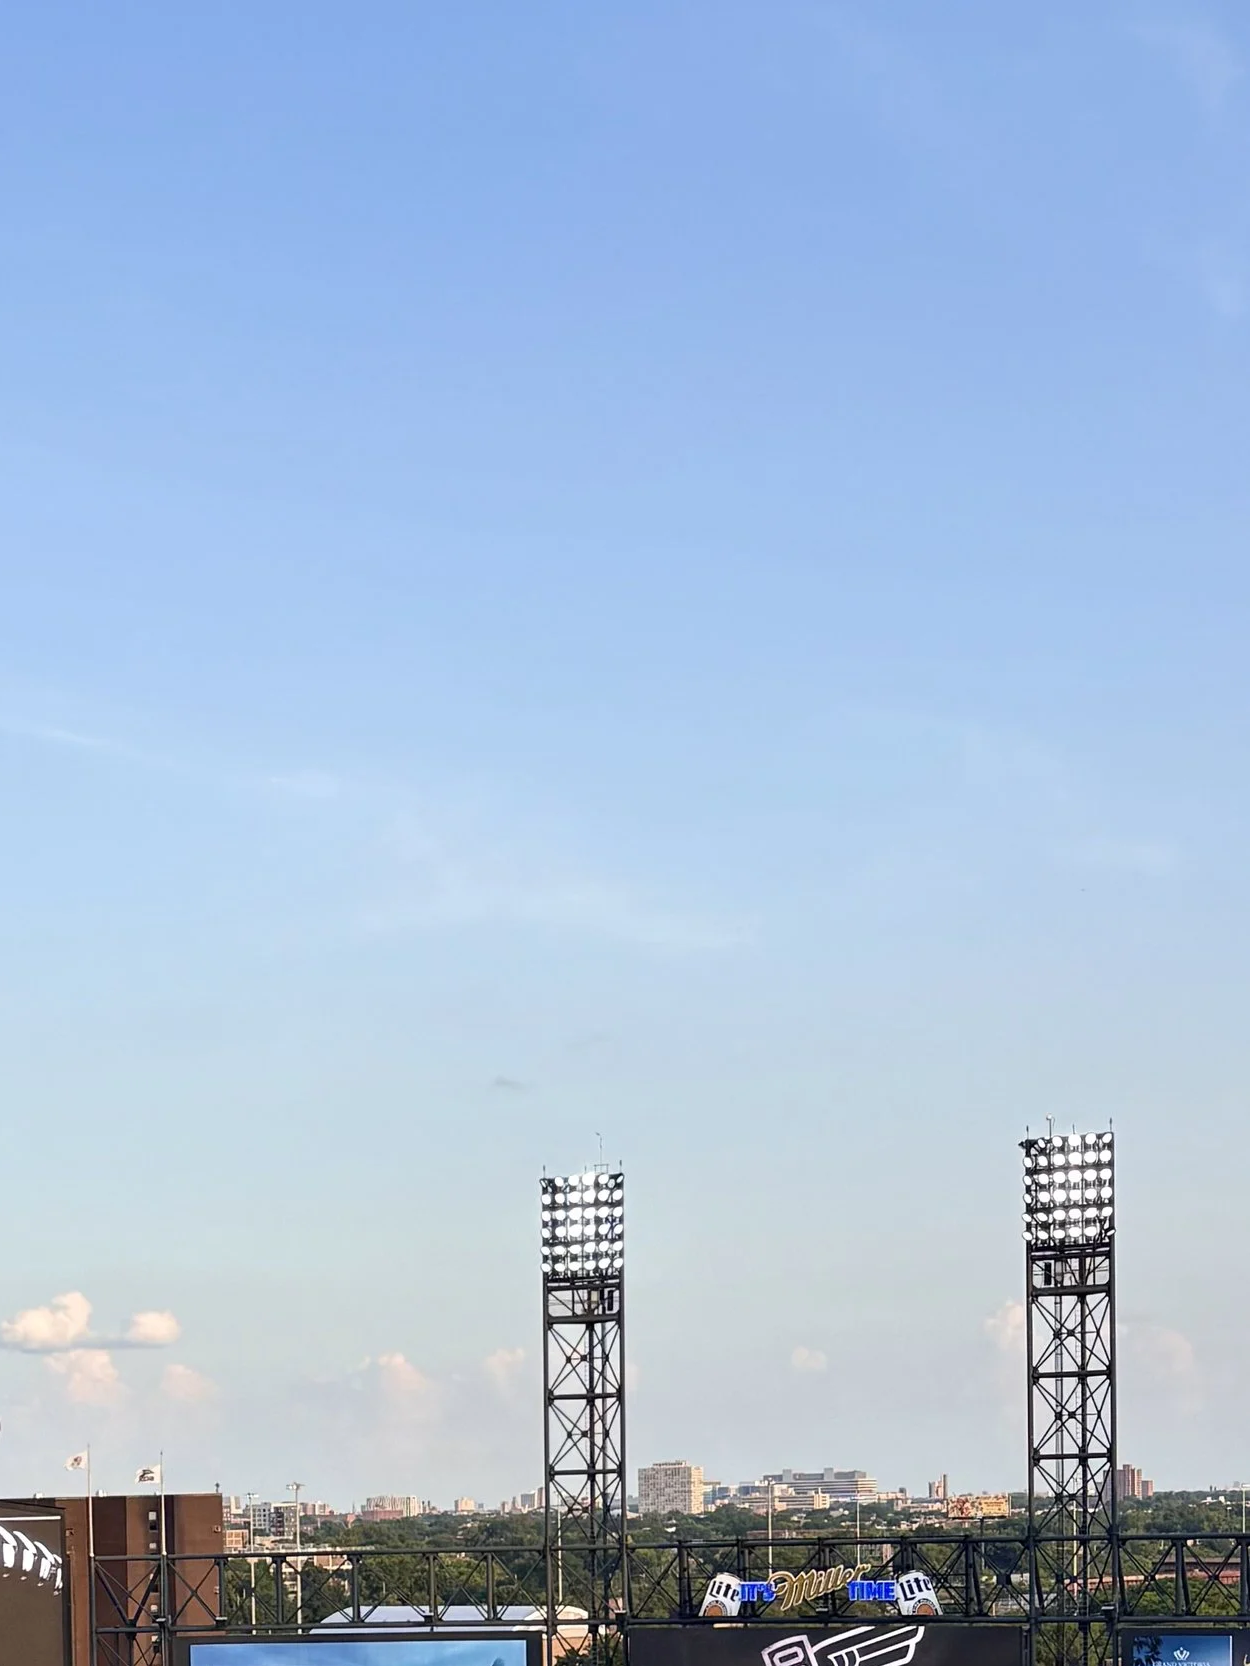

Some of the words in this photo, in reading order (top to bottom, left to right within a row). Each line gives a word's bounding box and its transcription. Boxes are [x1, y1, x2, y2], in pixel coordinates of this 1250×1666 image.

[709, 1581, 740, 1602] Lite
[739, 1583, 775, 1601] IT'S
[768, 1564, 871, 1611] Miller
[847, 1580, 896, 1601] TIME
[900, 1577, 932, 1601] Lite
